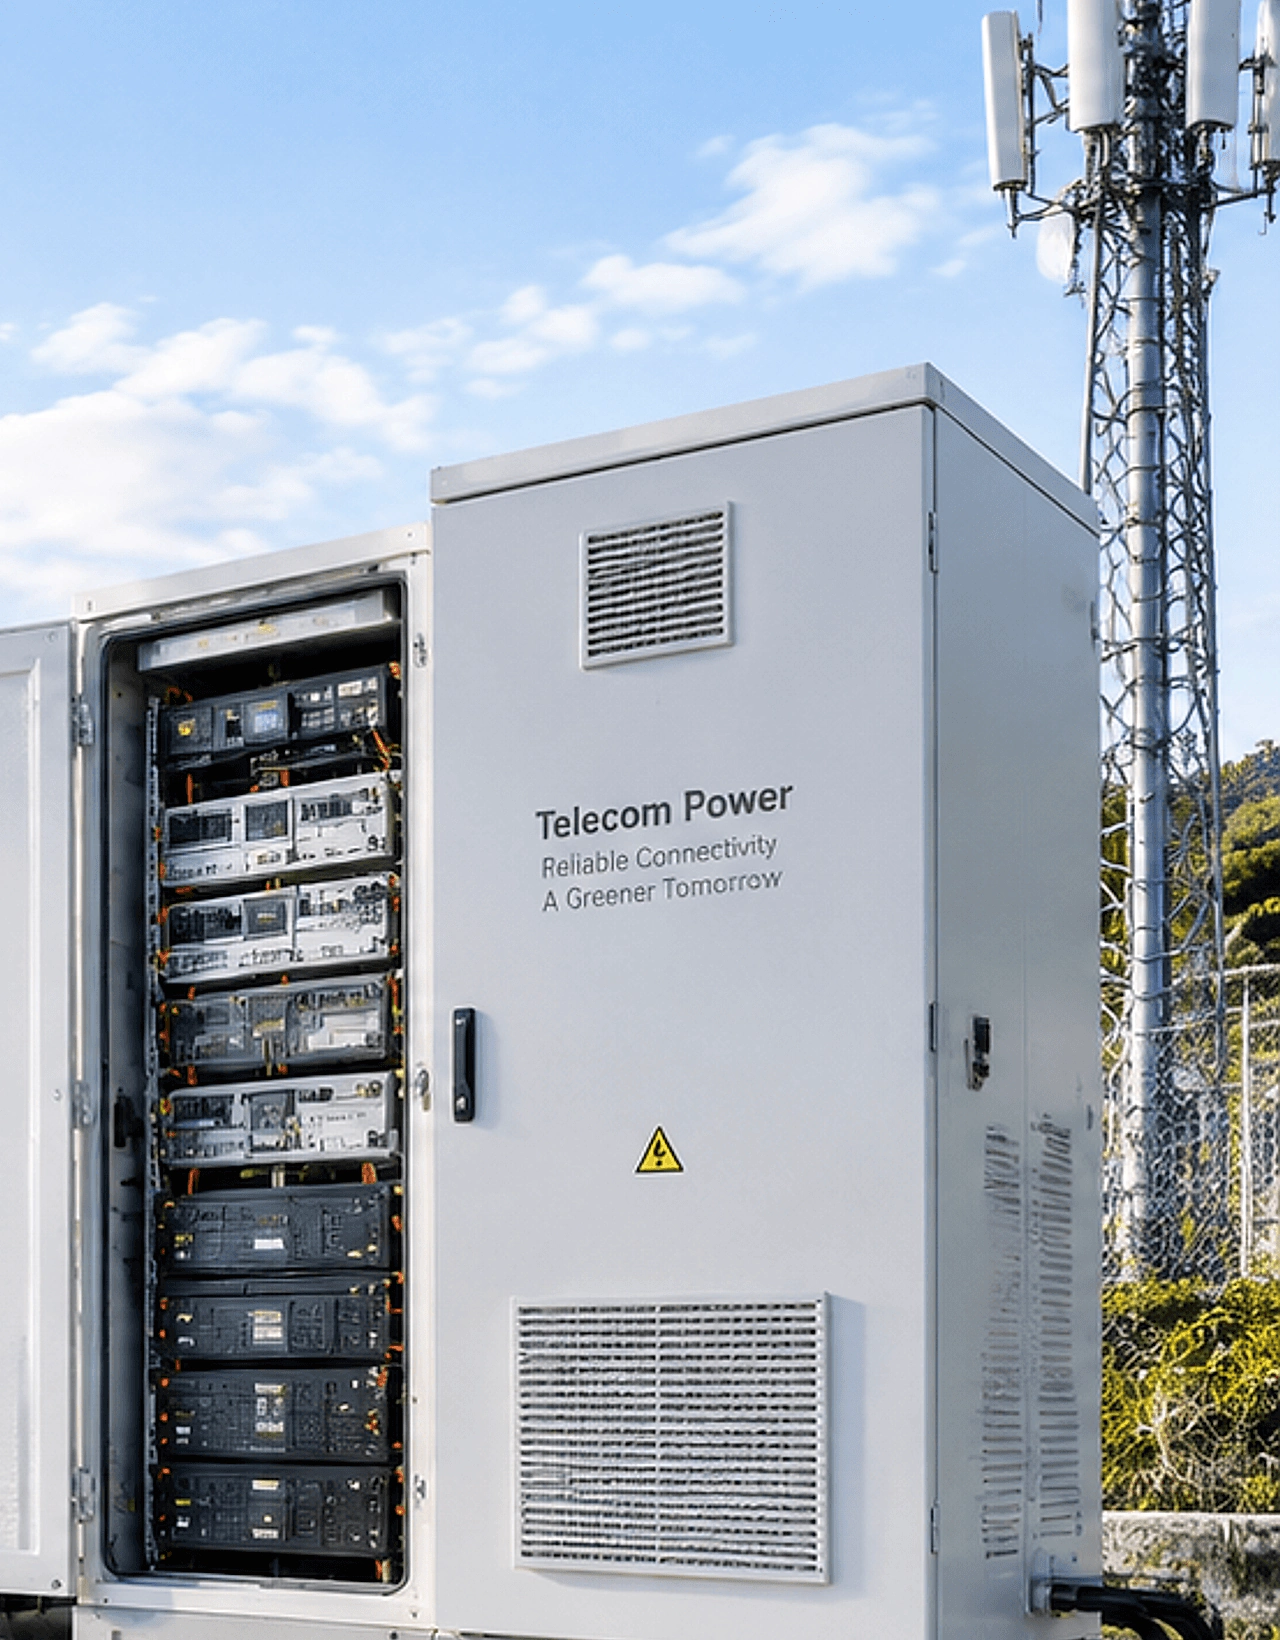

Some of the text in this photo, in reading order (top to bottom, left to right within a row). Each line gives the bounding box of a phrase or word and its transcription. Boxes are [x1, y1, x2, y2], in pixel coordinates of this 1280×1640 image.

[536, 785, 793, 839] Telecom Power
[542, 834, 777, 878] Reliable Connectivity
[542, 871, 783, 911] A Greener Tomorrow
